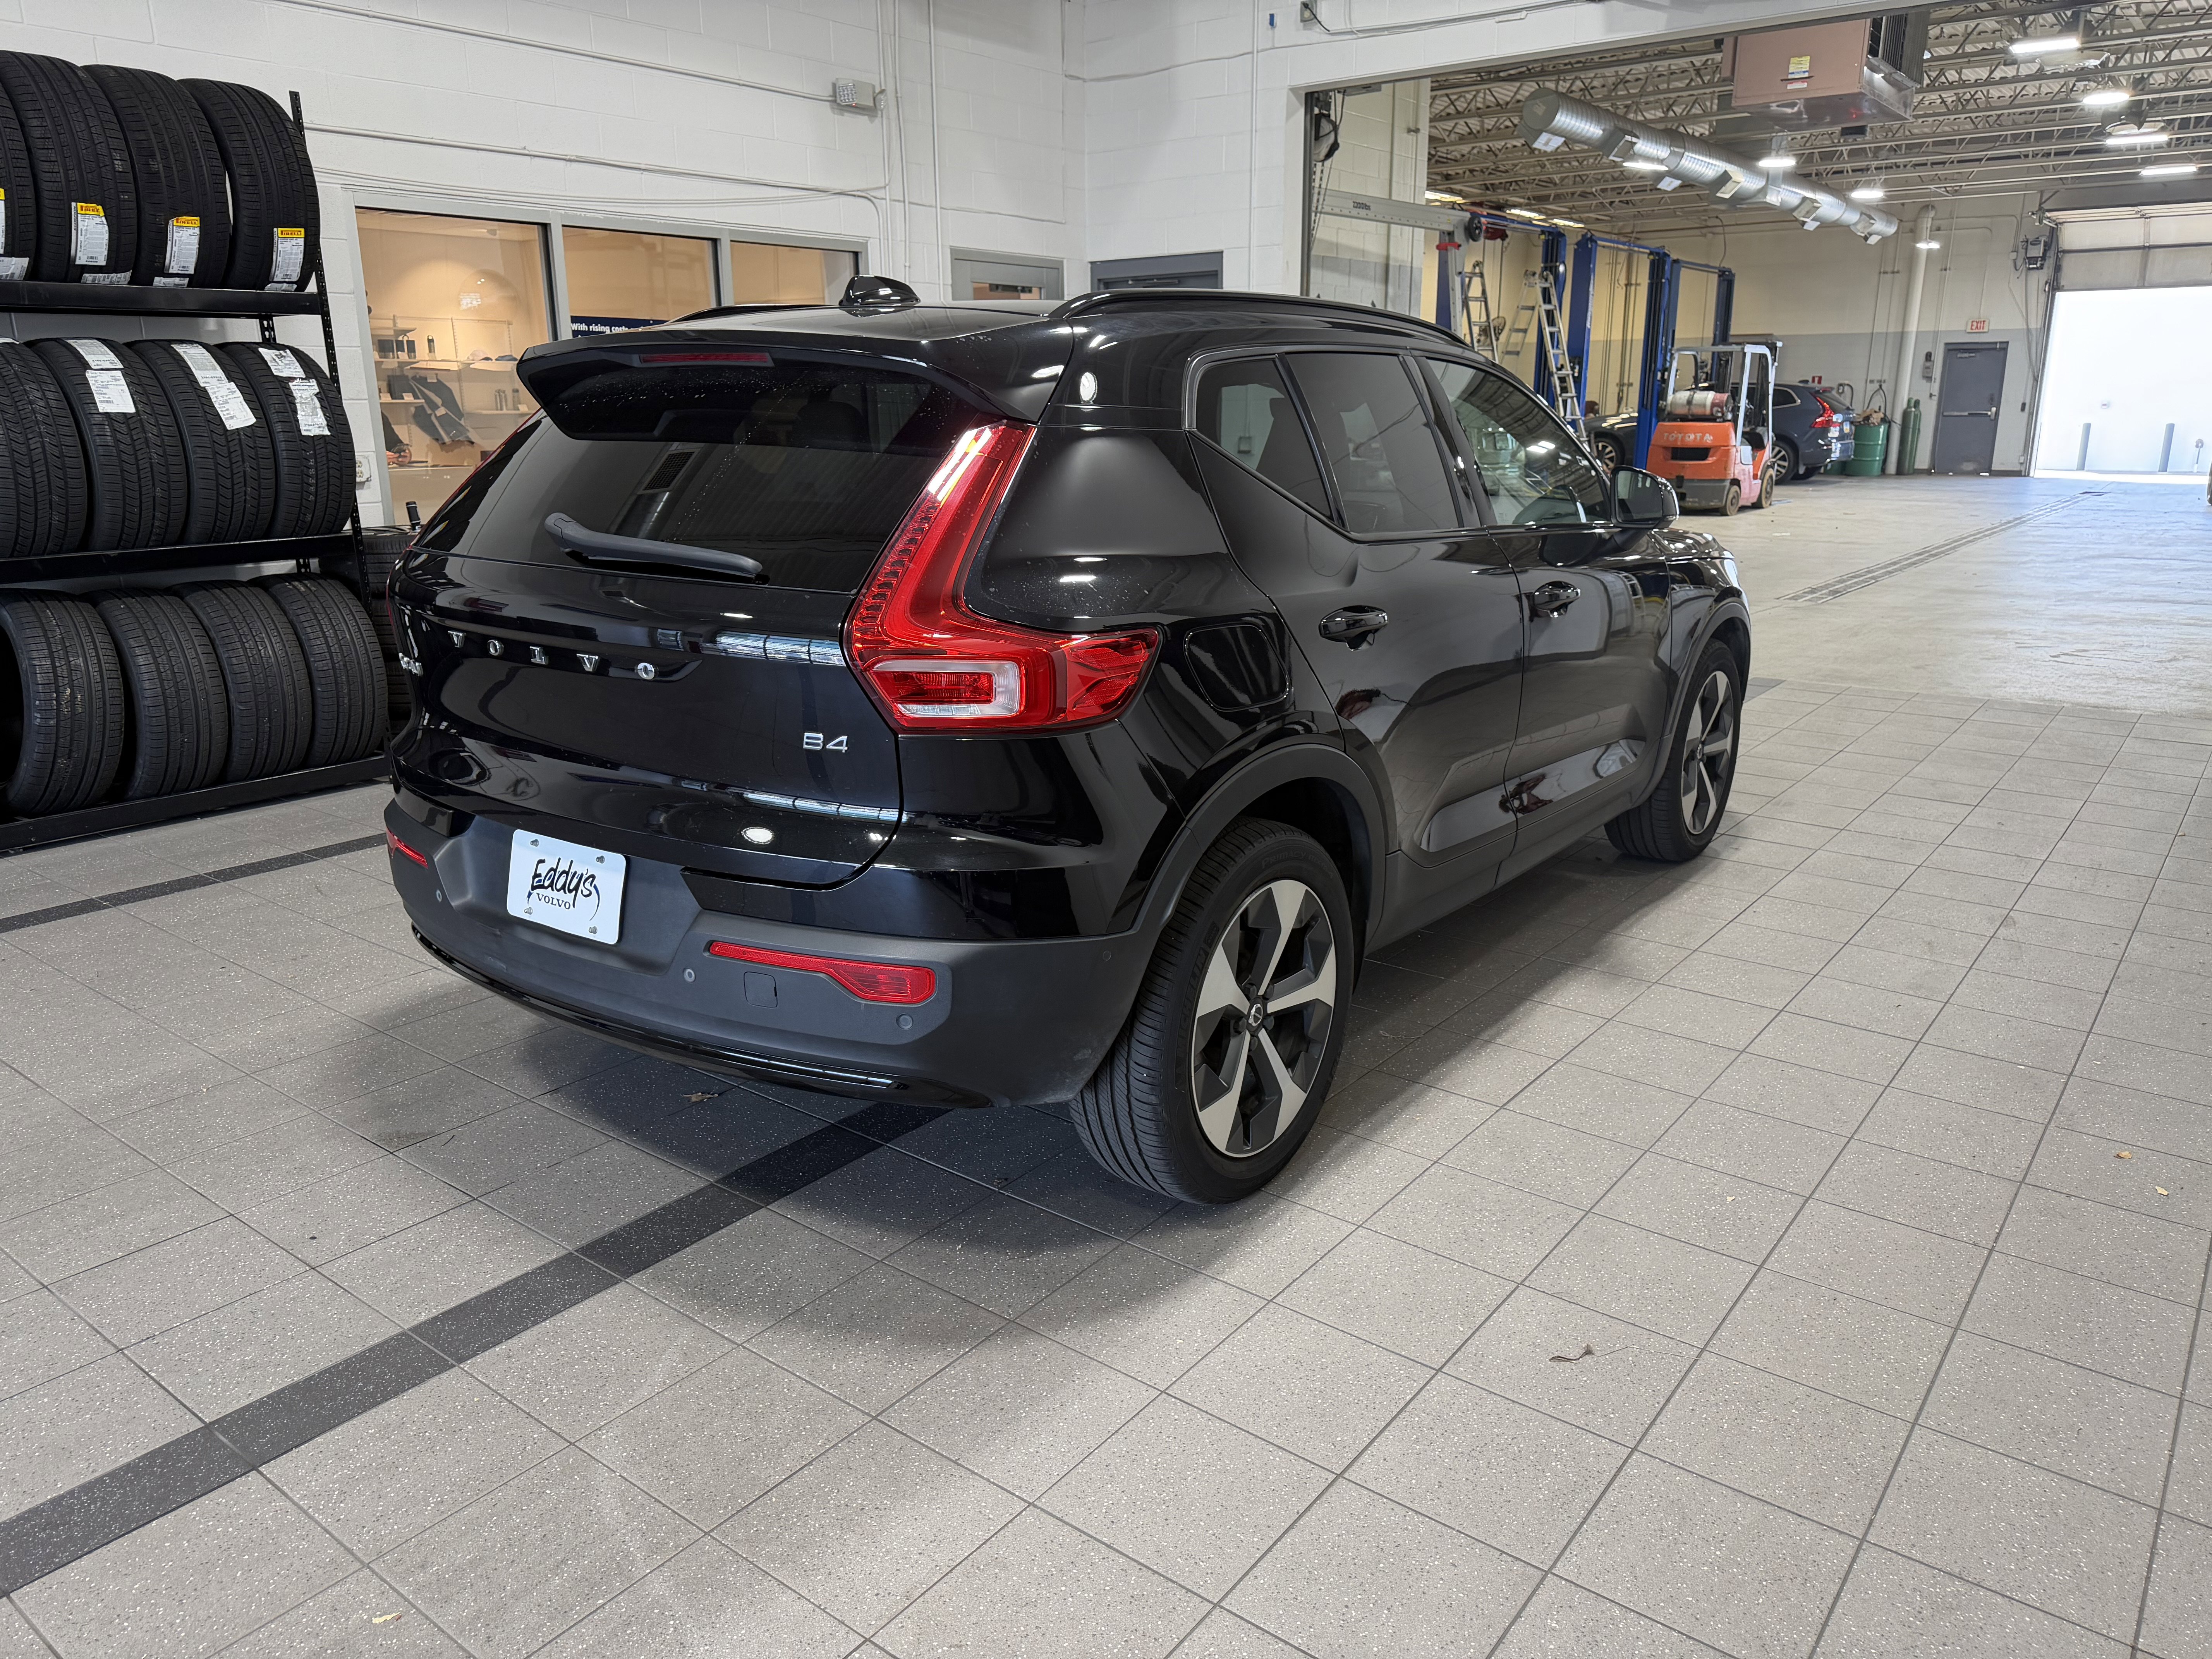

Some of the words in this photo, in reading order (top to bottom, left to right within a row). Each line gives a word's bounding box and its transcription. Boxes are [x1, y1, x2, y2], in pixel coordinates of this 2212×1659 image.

[589, 324, 610, 333] rising
[1970, 320, 1986, 330] EXIT
[1664, 433, 1711, 442] TOYOTA
[448, 630, 657, 680] VOLVO
[803, 732, 848, 753] B4
[531, 857, 596, 908] Eddy's
[536, 893, 571, 910] VOLVO
